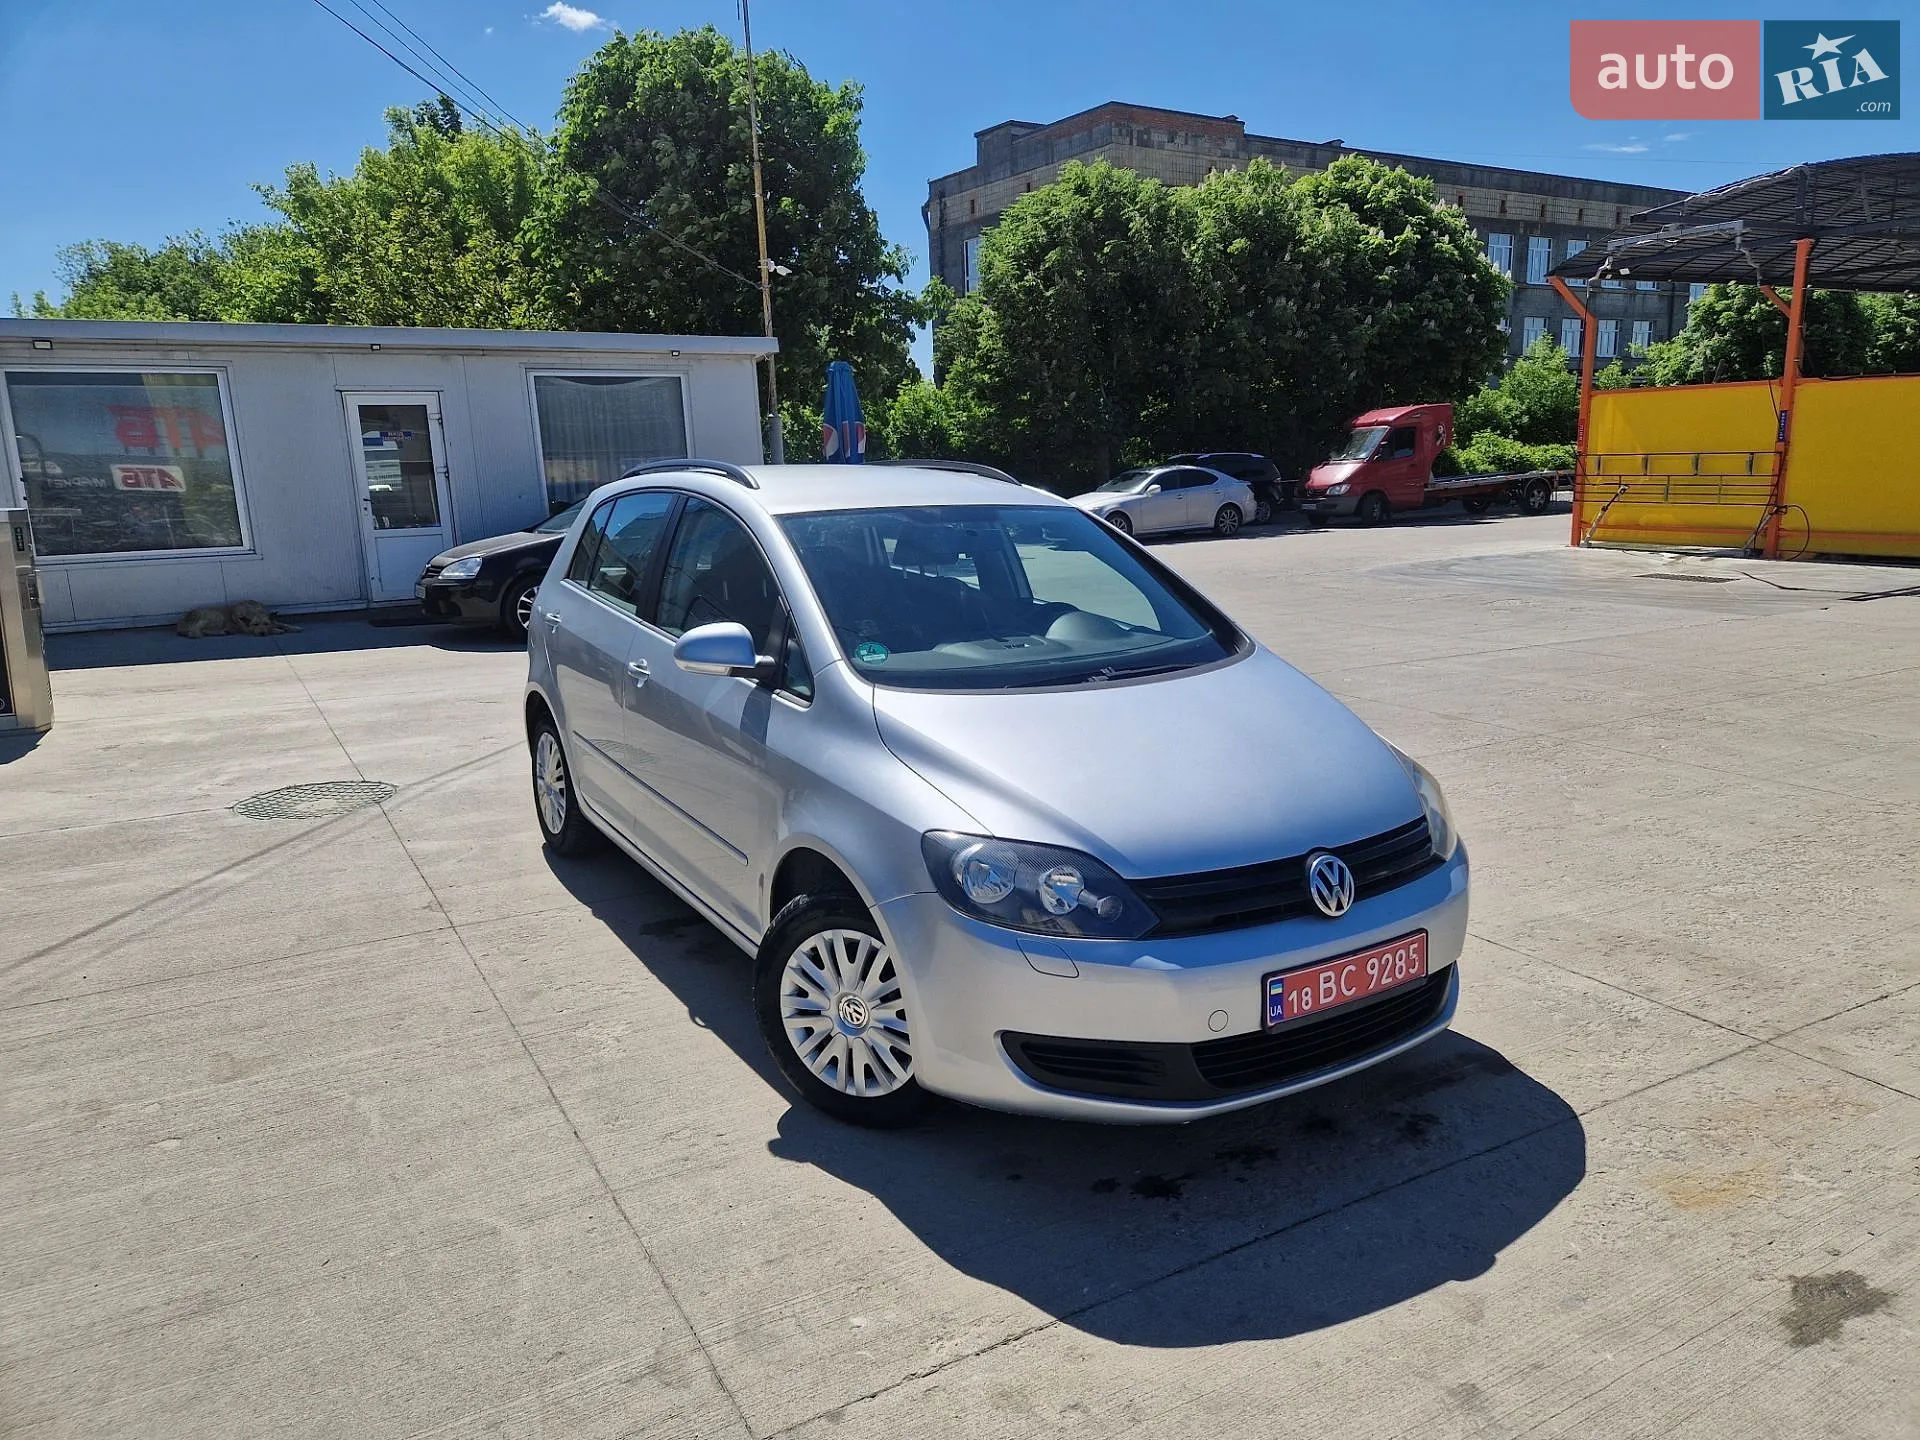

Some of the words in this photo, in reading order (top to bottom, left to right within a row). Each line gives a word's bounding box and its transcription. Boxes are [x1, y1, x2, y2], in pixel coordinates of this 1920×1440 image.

[1288, 986, 1312, 1014] 18
[1319, 965, 1357, 1004] BC
[1366, 943, 1419, 990] 9285
[1270, 1006, 1283, 1017] UA
